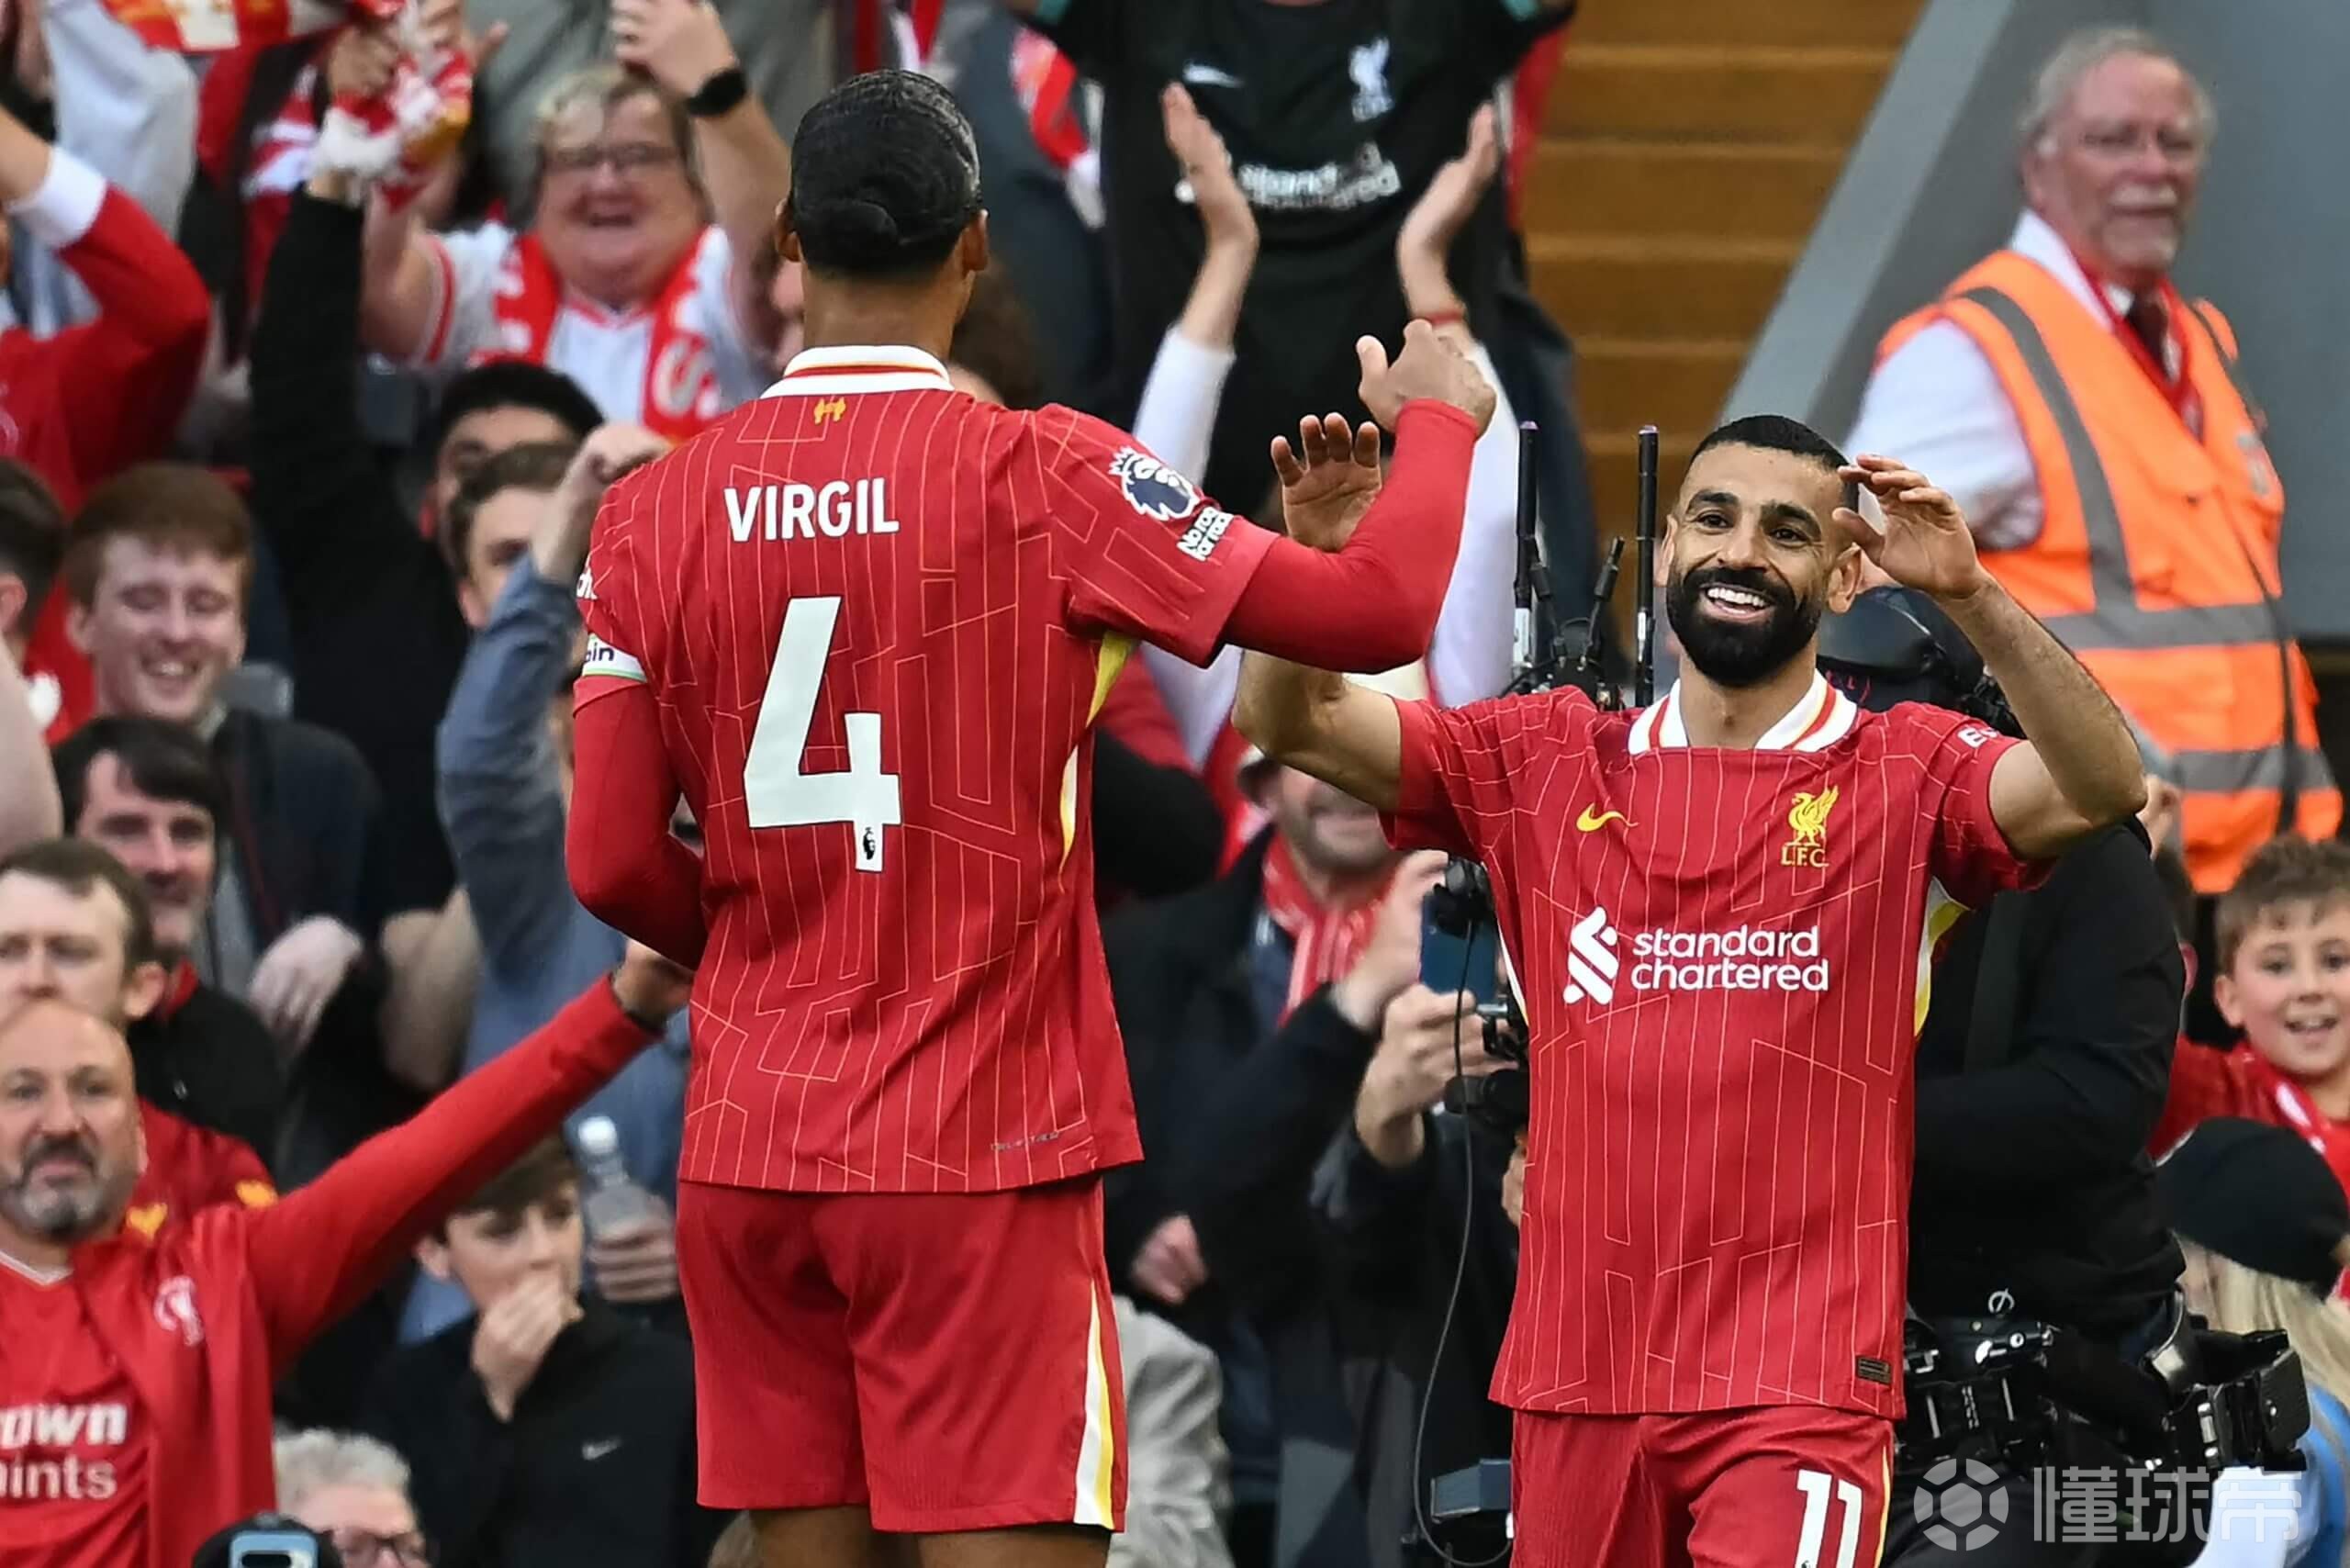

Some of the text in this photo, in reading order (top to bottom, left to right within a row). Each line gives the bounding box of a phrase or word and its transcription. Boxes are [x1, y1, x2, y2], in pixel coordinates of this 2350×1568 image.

[723, 477, 900, 542] VIRGIL
[744, 596, 902, 872] 4
[1632, 924, 1819, 958] standard
[1630, 958, 1830, 991] chartered
[1795, 1469, 1863, 1568] 11
